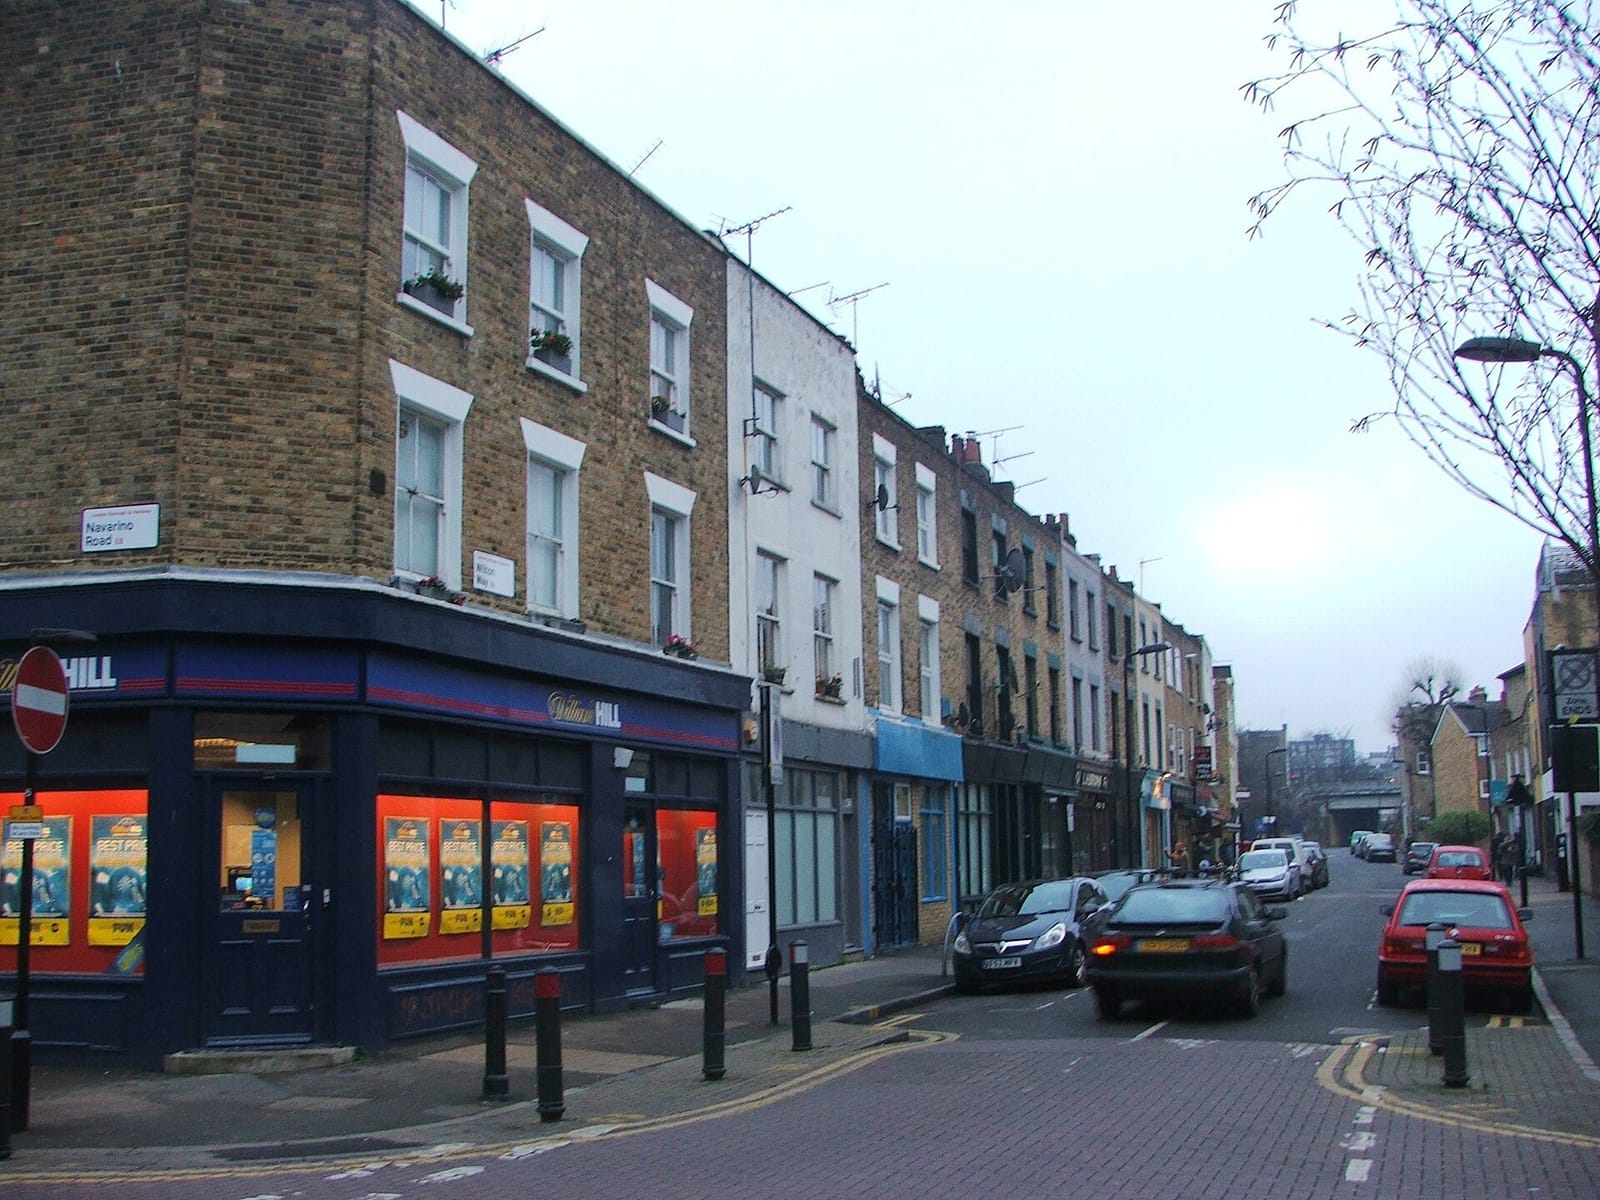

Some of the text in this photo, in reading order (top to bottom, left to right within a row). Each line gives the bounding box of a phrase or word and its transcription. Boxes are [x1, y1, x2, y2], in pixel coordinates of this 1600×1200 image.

[86, 521, 134, 533] Navarino
[86, 534, 112, 546] Road
[59, 656, 117, 689] HILL
[595, 701, 622, 729] HILL
